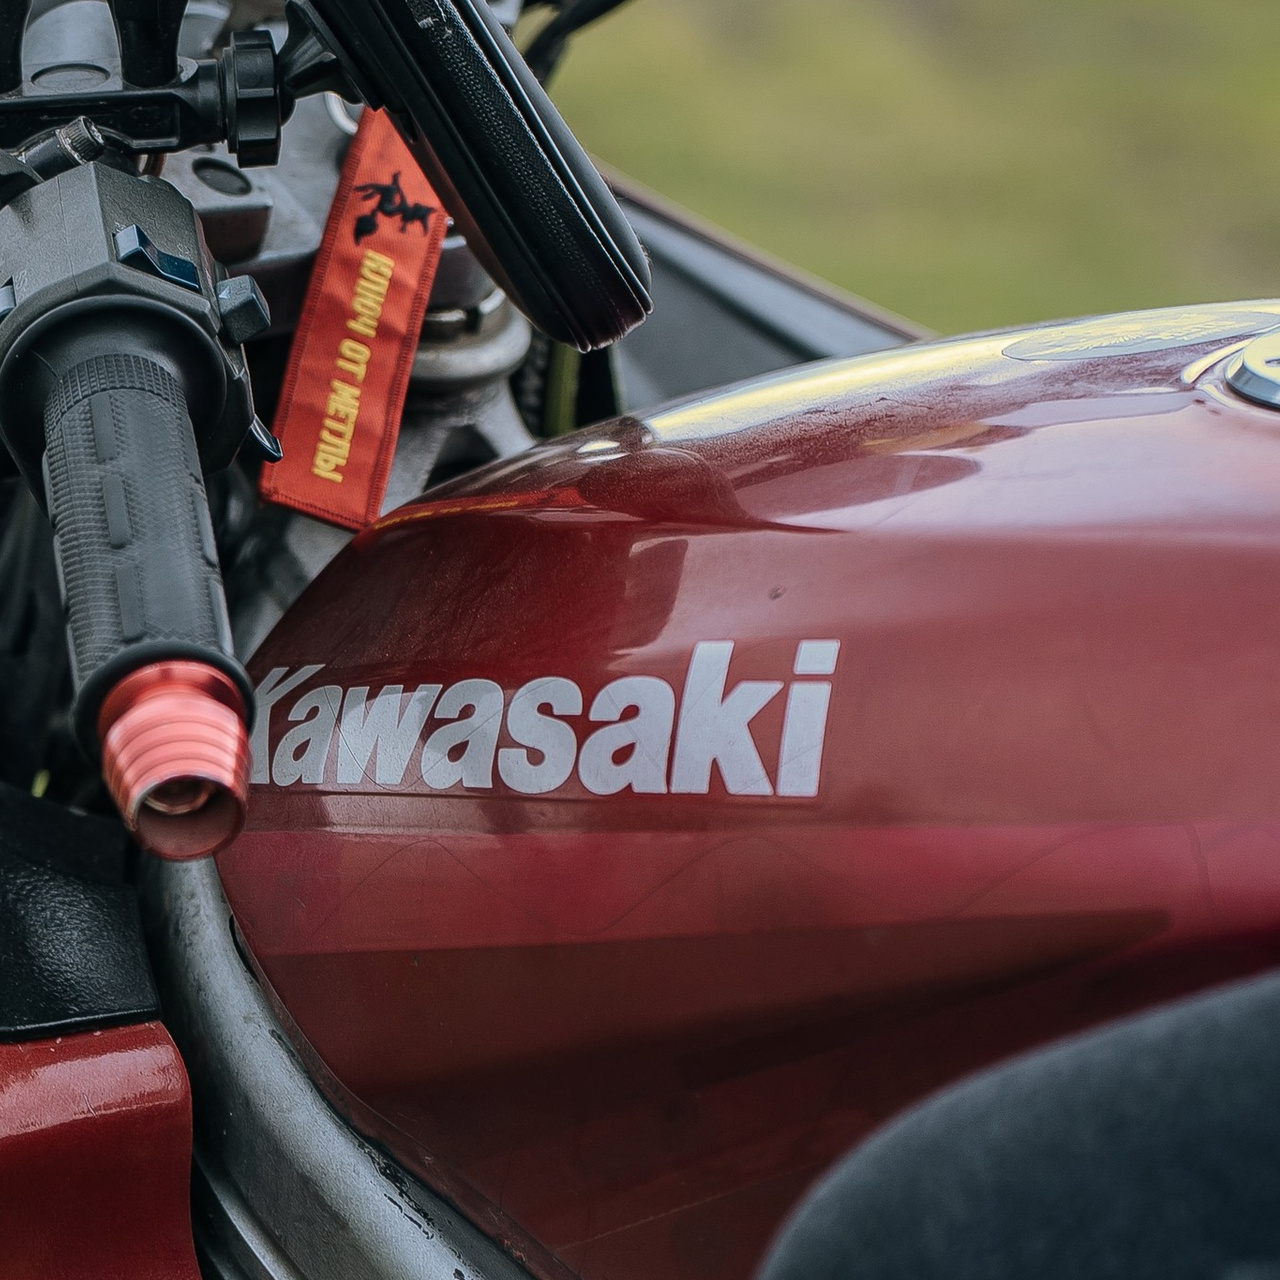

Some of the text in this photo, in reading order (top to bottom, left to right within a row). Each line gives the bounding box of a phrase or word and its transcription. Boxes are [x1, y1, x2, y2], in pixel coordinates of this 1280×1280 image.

[312, 249, 395, 483] КЛЮЧ ОТ МЕТЛЫ
